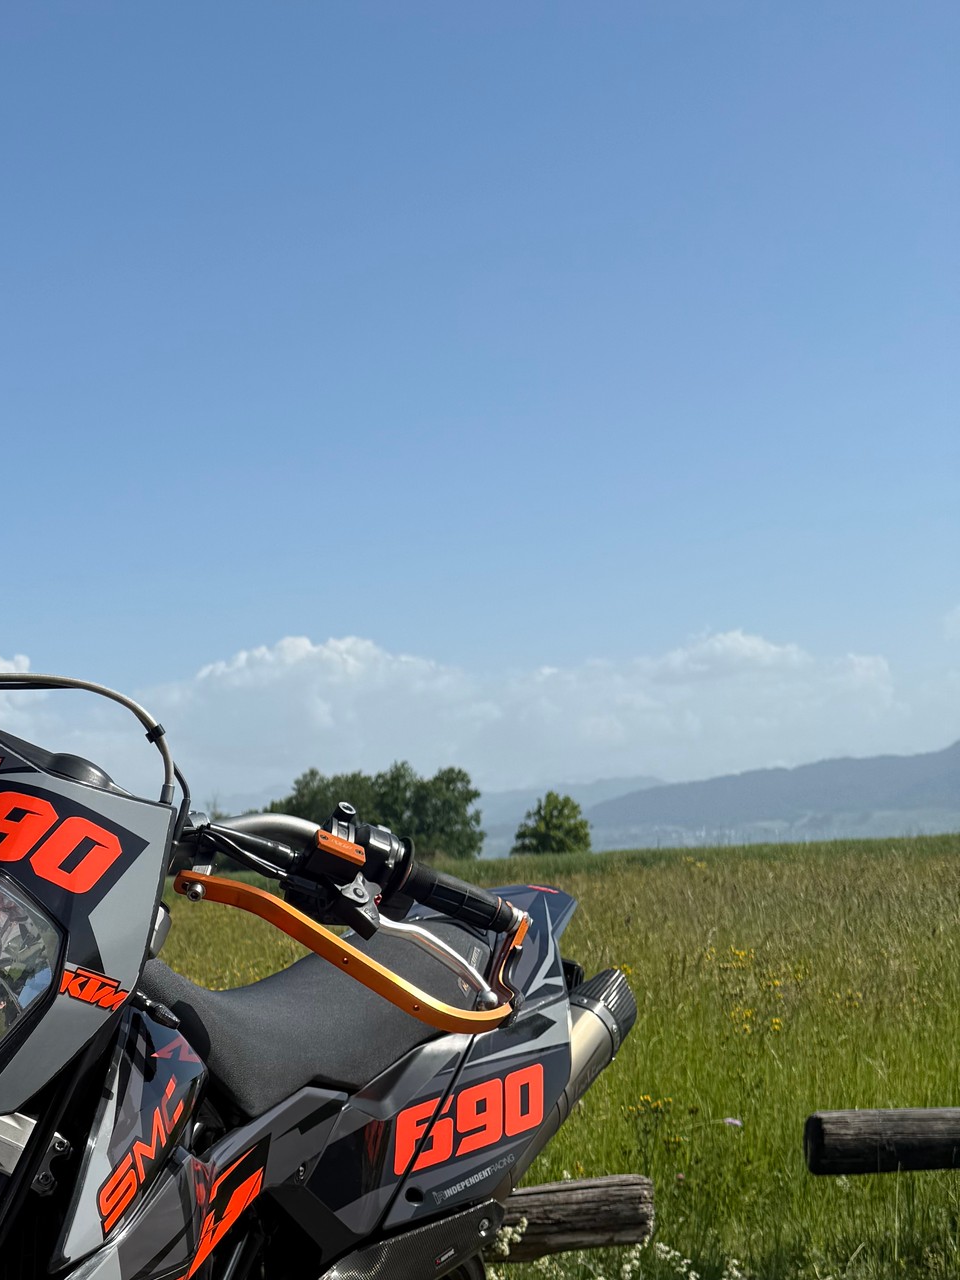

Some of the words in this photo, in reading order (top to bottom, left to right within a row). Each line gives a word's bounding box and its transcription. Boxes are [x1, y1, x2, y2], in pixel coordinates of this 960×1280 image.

[59, 968, 129, 1011] KTM
[99, 1074, 184, 1233] SMC
[394, 1063, 544, 1176] 690
